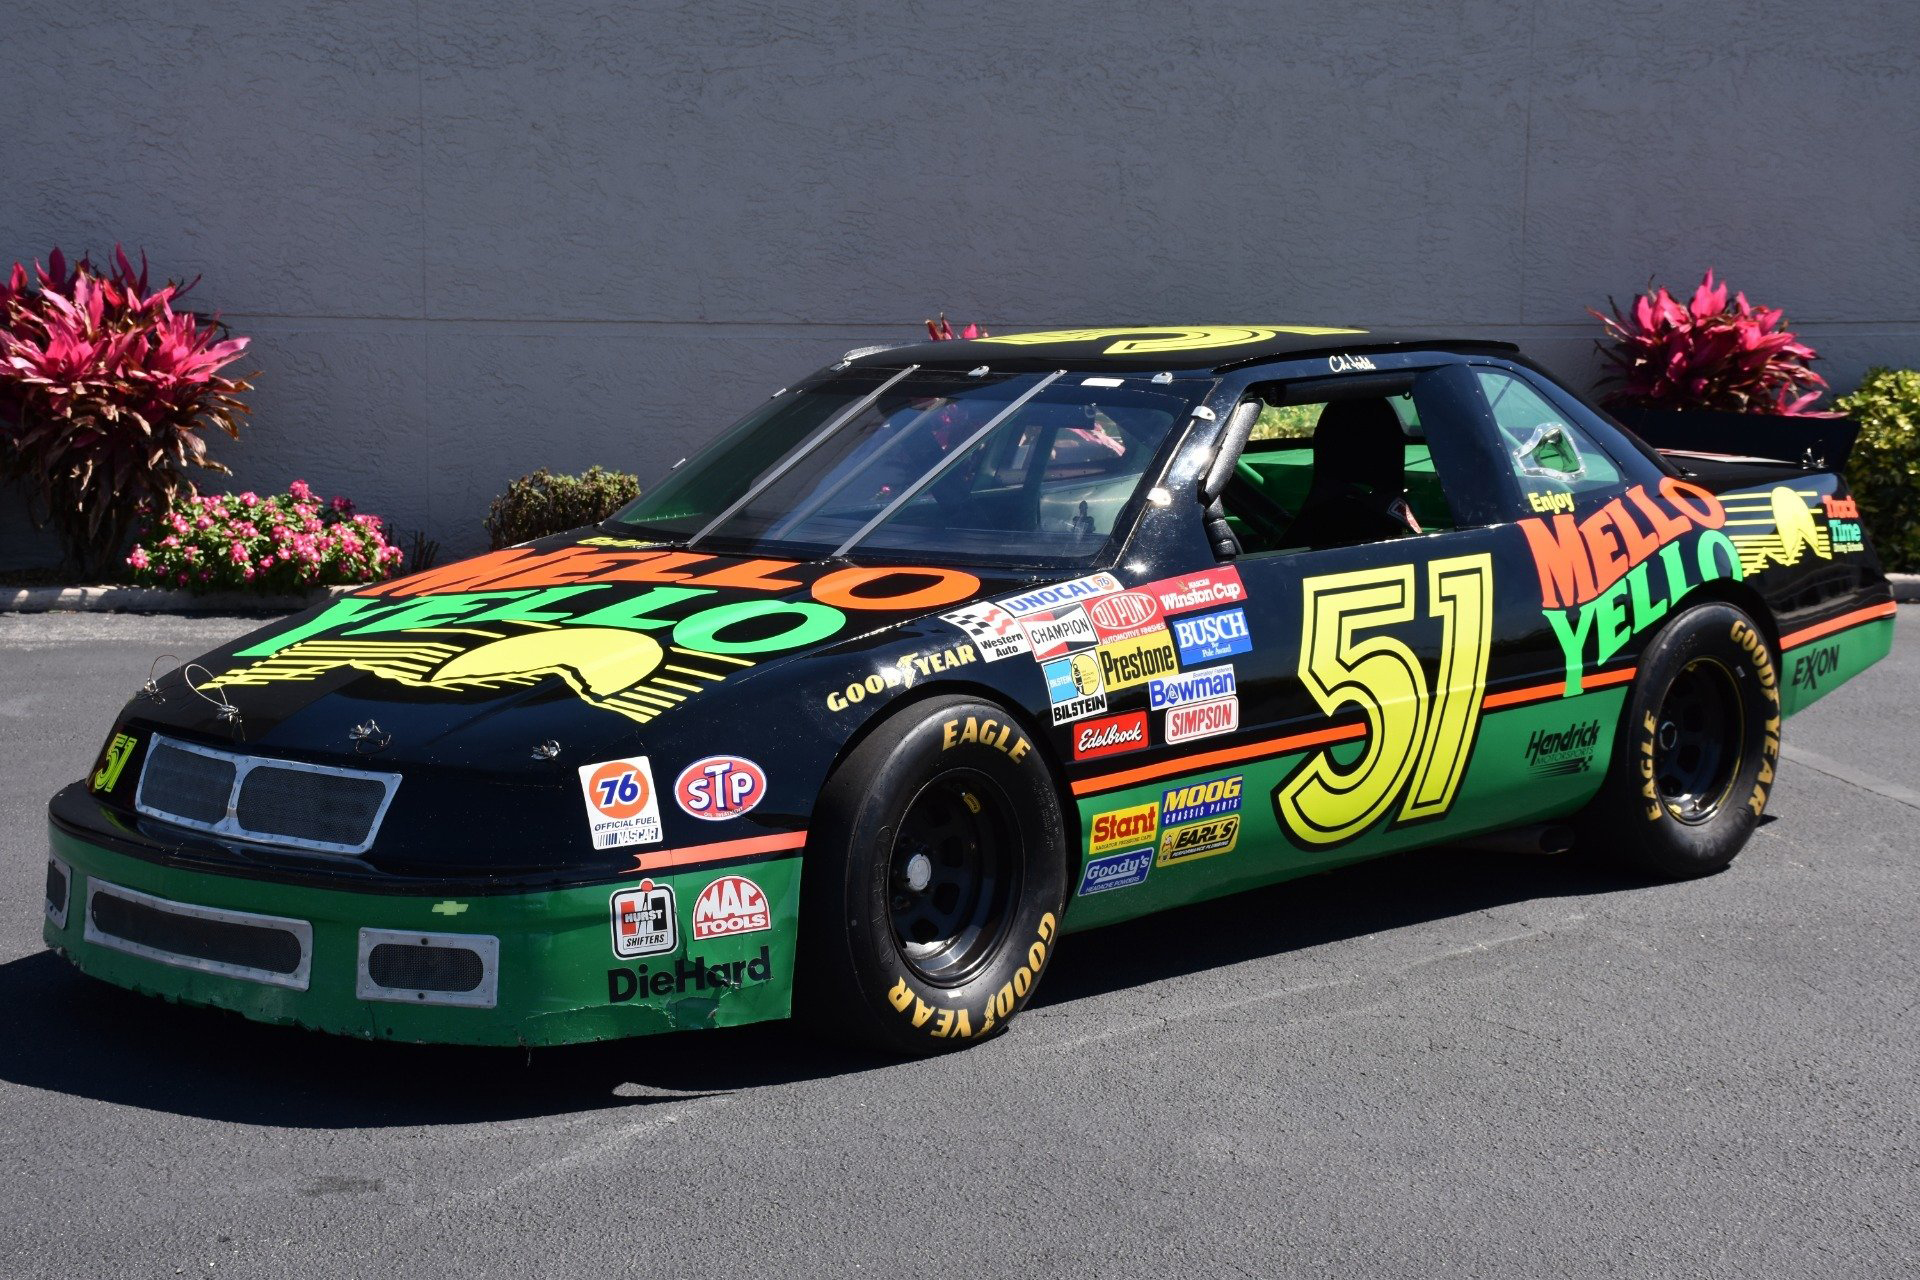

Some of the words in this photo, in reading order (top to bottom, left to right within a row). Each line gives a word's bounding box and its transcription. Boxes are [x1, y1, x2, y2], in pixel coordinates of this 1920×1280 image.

[1527, 490, 1575, 515] Enjoy
[1516, 476, 1727, 608] MELLO
[1828, 519, 1862, 542] Time
[353, 546, 982, 611] MELLO
[1004, 580, 1101, 612] UNOCAL
[1096, 577, 1111, 589] 76
[1159, 588, 1215, 611] Winston
[1212, 582, 1241, 600] Cup
[1541, 530, 1744, 698] YELLO
[231, 584, 847, 659] YELLO
[1030, 617, 1090, 645] CHAMPION
[1101, 630, 1141, 645] AUTOMOTIVE
[1140, 622, 1167, 636] FINISHES
[1174, 611, 1249, 649] BUSCH
[980, 632, 1024, 650] Western
[995, 644, 1020, 658] Auto
[1098, 642, 1175, 686] Prestone
[1149, 672, 1235, 708] Bowman
[1276, 551, 1494, 846] 51
[1053, 694, 1106, 722] BILSTEIN
[1171, 702, 1233, 737] SIMPSON
[942, 717, 1033, 765] EAGLE
[1077, 718, 1144, 753] Edelbrock
[1525, 718, 1601, 767] Hendrick
[94, 732, 139, 793] 51
[1639, 710, 1663, 823] EAGLE
[597, 771, 641, 808] 76
[686, 761, 756, 811] STP
[1162, 776, 1242, 813] MOOG
[594, 819, 634, 832] OFFICIAL
[634, 816, 658, 826] FUEL
[1093, 806, 1156, 843] Stant
[1165, 806, 1205, 825] CHASSIS
[1209, 798, 1239, 814] PARTS
[1173, 821, 1236, 849] EARL'S
[1086, 855, 1150, 881] Goody's
[623, 908, 664, 924] HURST
[696, 879, 767, 922] MAC
[626, 934, 666, 948] SHIFTERS
[696, 914, 767, 936] TOOLS
[607, 944, 773, 1004] DieHard
